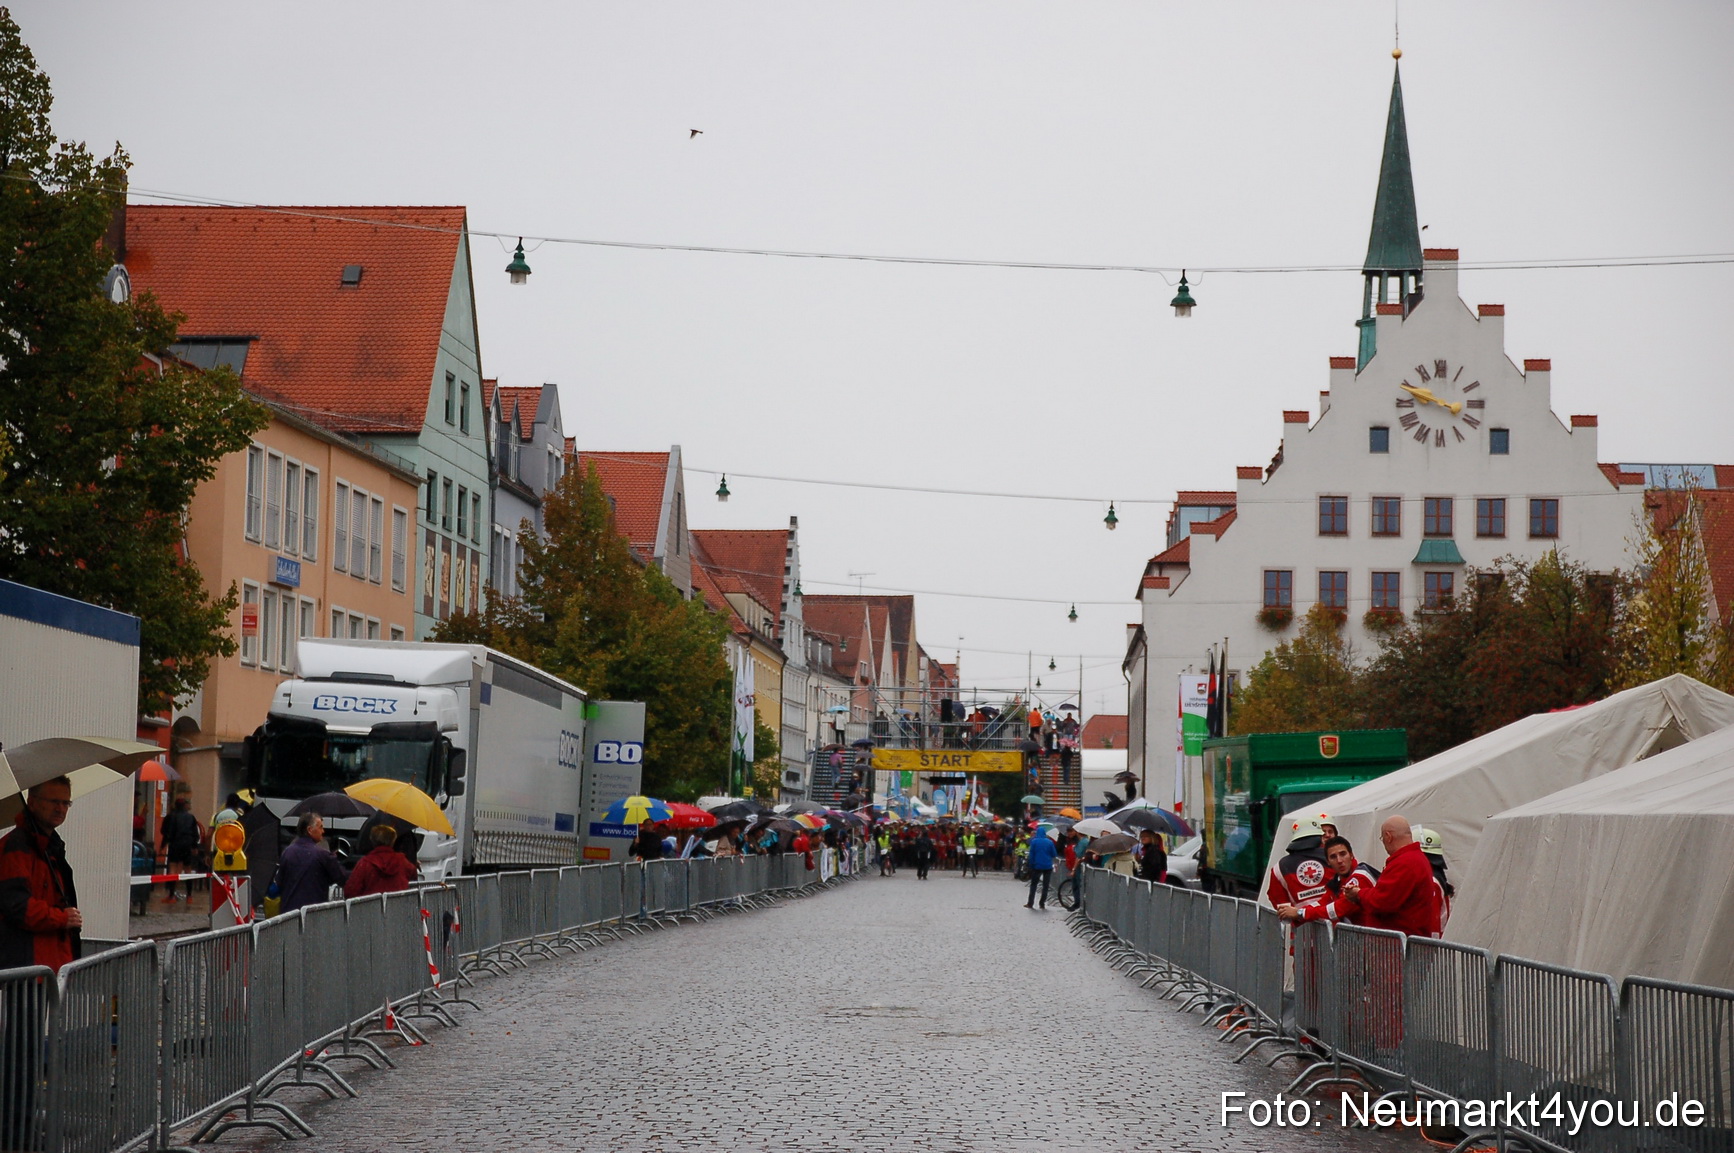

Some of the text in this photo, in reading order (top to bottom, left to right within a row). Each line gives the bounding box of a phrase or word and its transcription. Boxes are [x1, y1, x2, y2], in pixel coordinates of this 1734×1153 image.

[312, 694, 398, 714] BOCK
[558, 729, 580, 770] BOCK
[593, 740, 643, 765] BO
[920, 754, 972, 767] START
